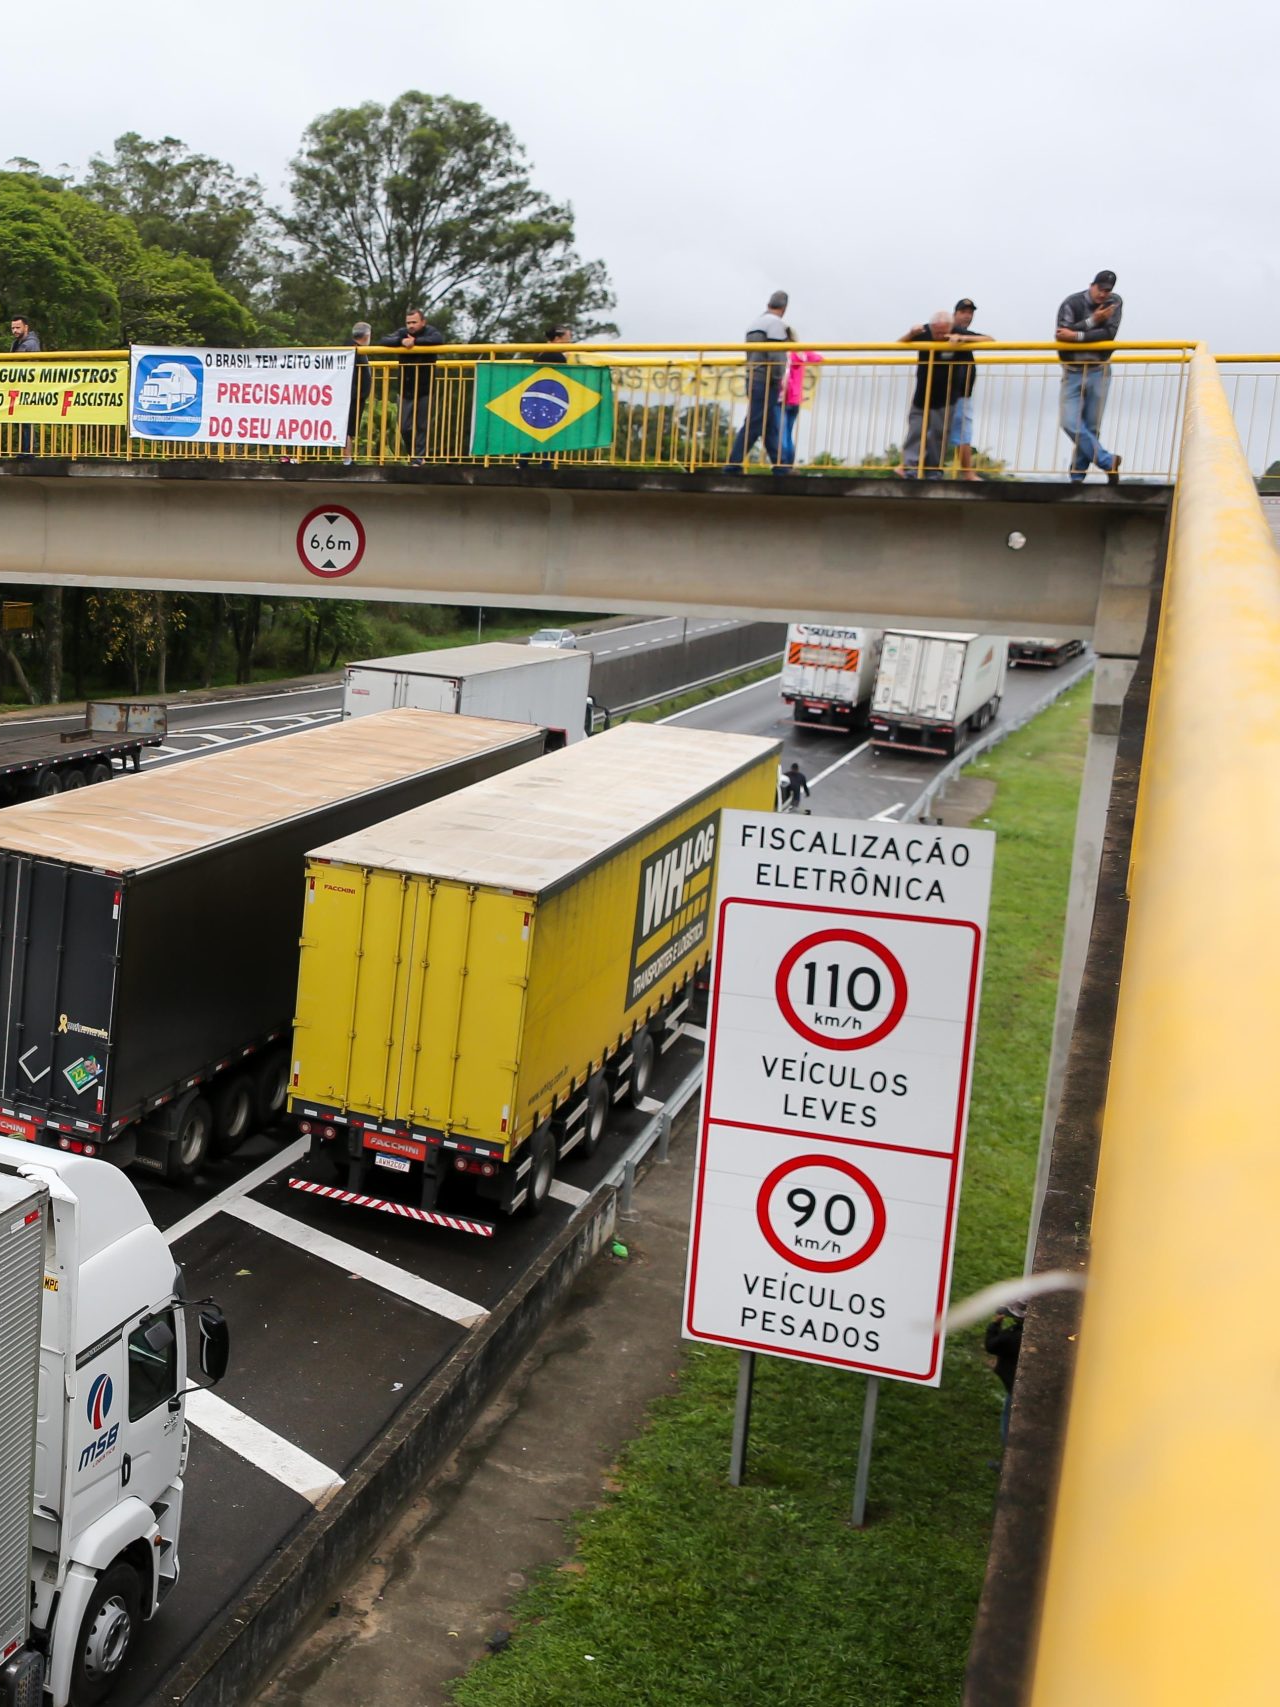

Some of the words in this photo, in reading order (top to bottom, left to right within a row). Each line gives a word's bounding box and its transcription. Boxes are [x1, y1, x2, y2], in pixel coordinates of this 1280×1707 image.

[205, 354, 212, 367] O
[215, 354, 253, 369] BRASIL
[256, 355, 277, 369] TEM
[280, 355, 311, 369] JEITO
[314, 355, 334, 370] SIM
[337, 355, 347, 370] !!!
[39, 368, 118, 383] MINISTROS
[8, 390, 59, 415] TIRANOS
[61, 390, 124, 416] FASCISTAS
[217, 383, 333, 406] PRECISAMOS
[209, 416, 233, 437] DO
[237, 417, 271, 439] SEU
[276, 419, 338, 441] APOIO.
[324, 884, 356, 895] FACCHINI
[756, 863, 946, 903] ELETRÔNICA
[805, 962, 881, 1012] 110
[815, 1012, 862, 1030] km/h
[72, 1068, 86, 1082] 22
[762, 1052, 908, 1096] VEÍCULOS
[784, 1093, 877, 1128] LEVES
[370, 1137, 419, 1155] FACCHINI
[787, 1188, 856, 1236] 90
[794, 1235, 841, 1254] km/h
[743, 1272, 886, 1319] VEÍCULOS
[740, 1307, 880, 1352] PESADOS
[78, 1422, 120, 1472] MSB
